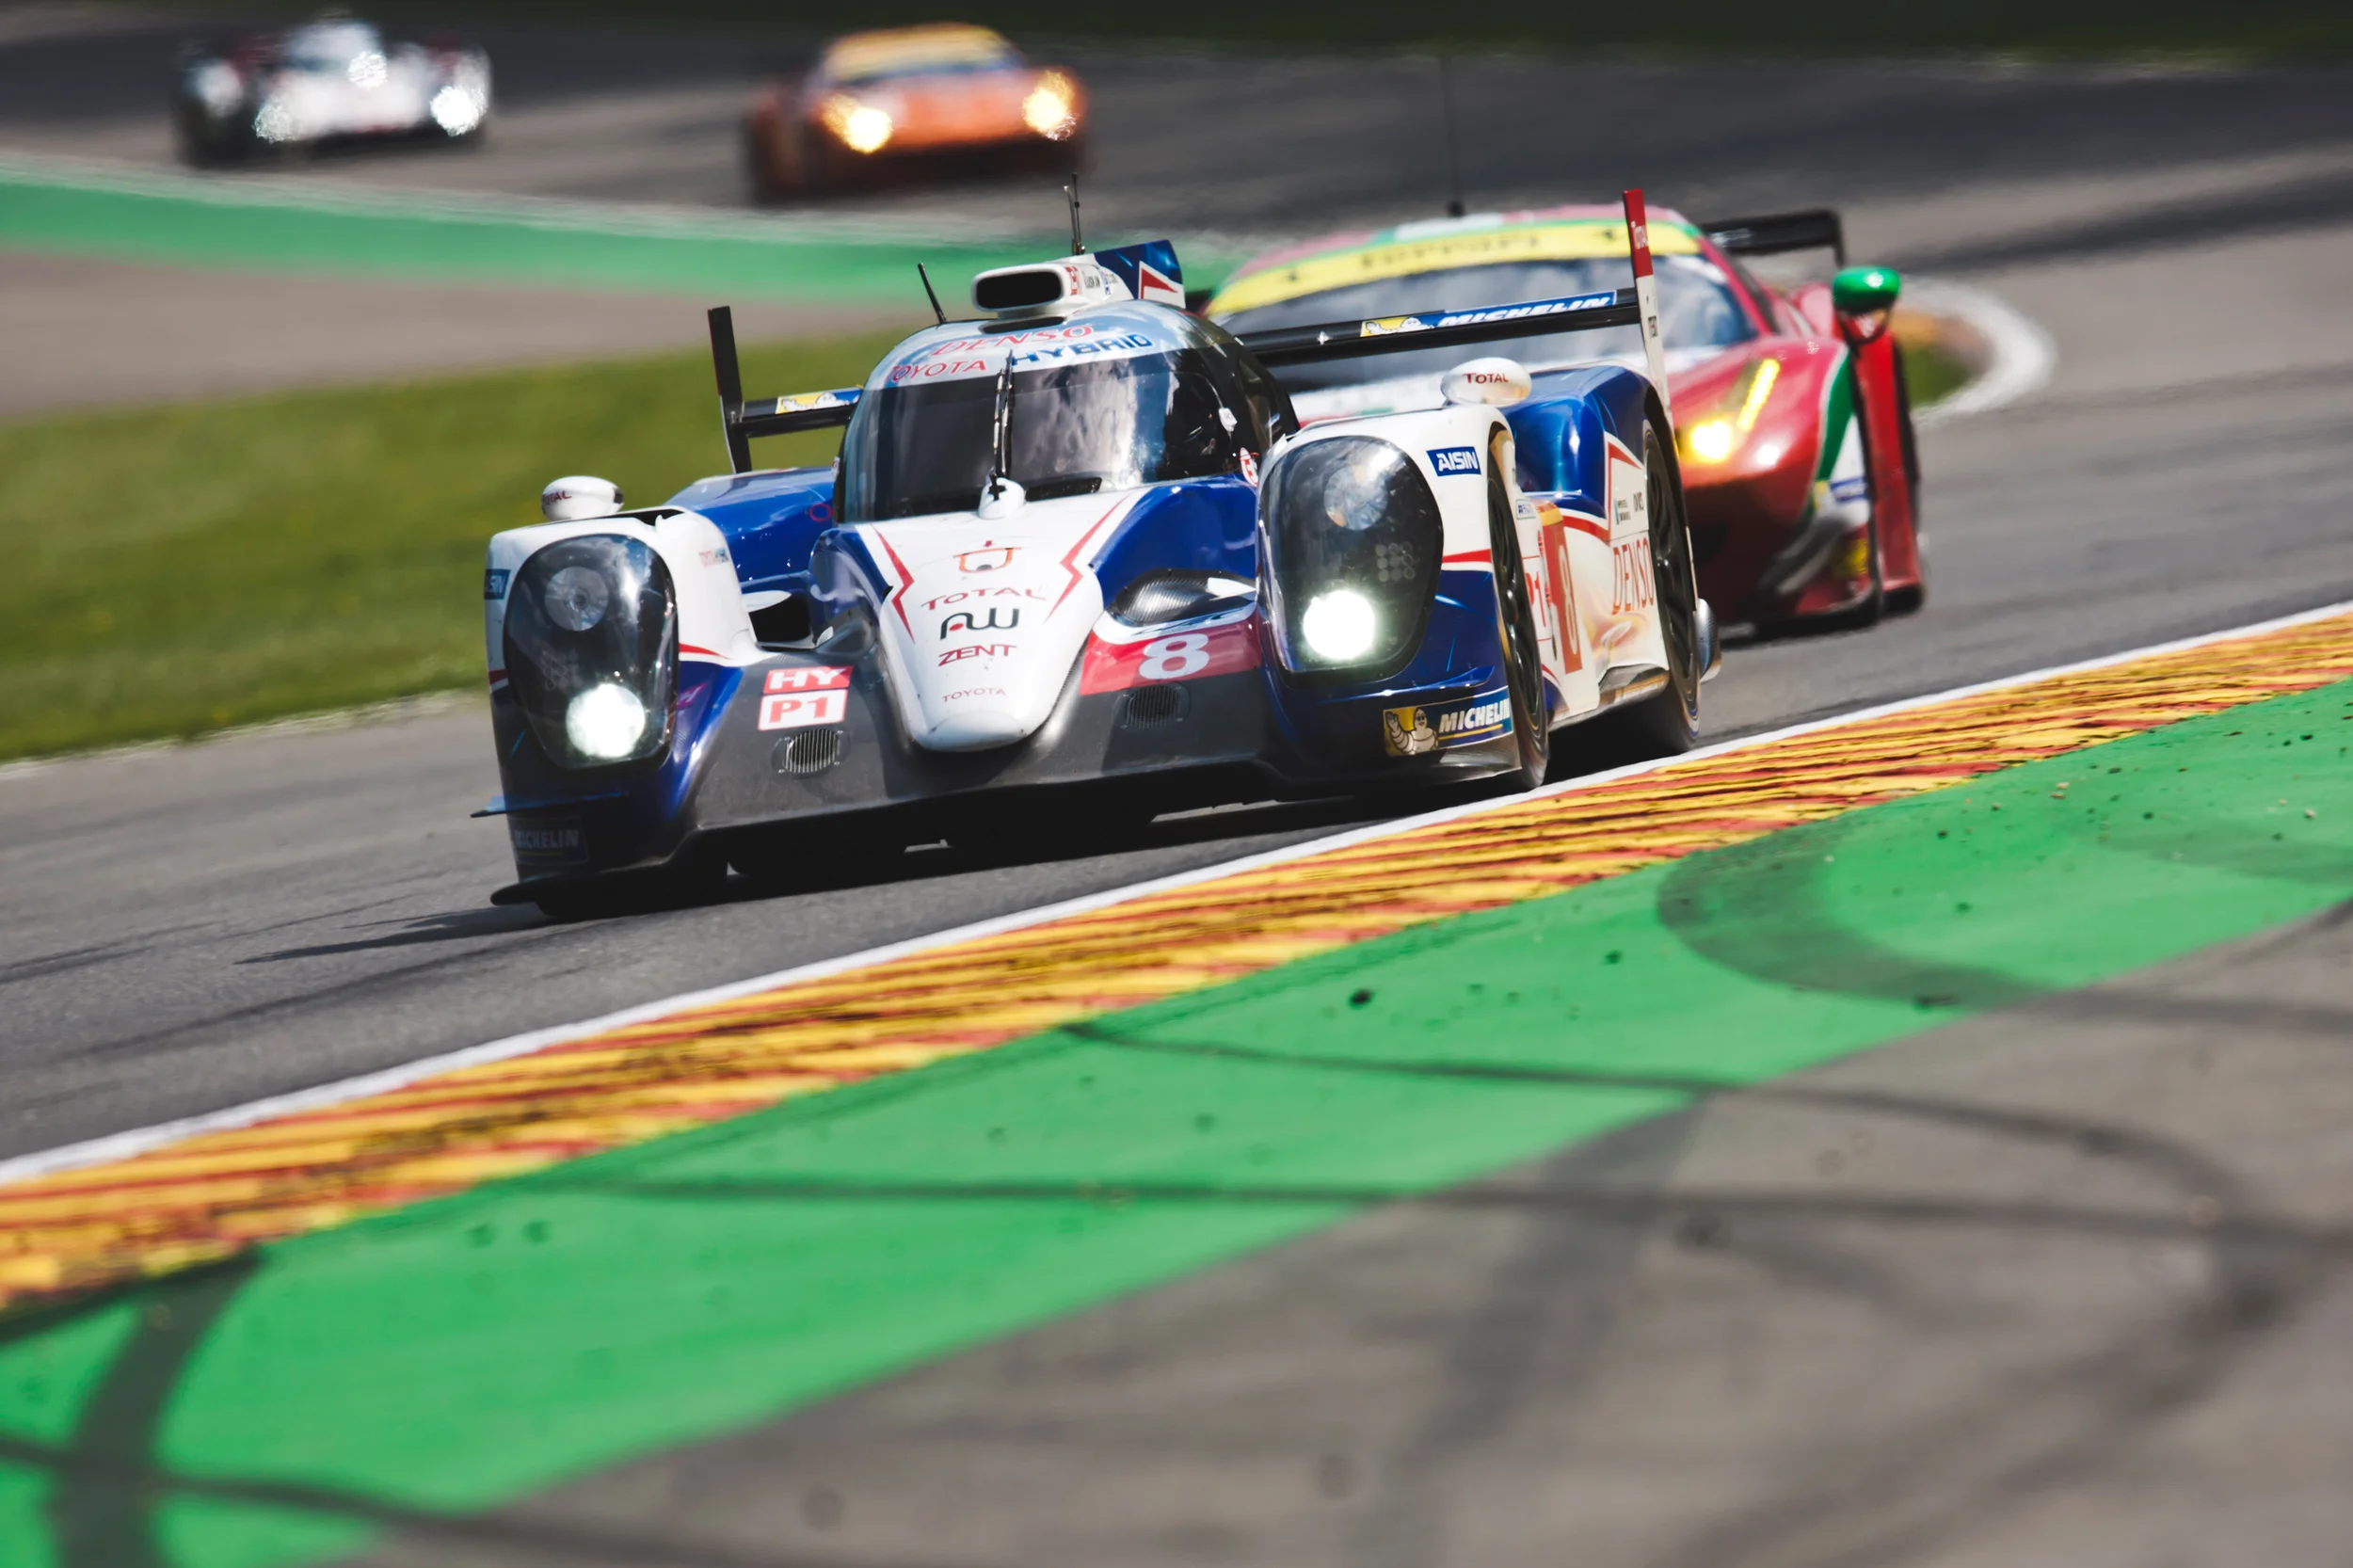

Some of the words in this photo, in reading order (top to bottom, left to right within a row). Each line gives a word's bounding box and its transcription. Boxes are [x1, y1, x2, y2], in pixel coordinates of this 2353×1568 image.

[1437, 296, 1611, 327] MICHELIN
[931, 325, 1094, 357] DENSO
[885, 360, 987, 382] TOYOTA
[1011, 333, 1154, 366] HYBRID
[1462, 373, 1509, 384] TOTAL
[1436, 451, 1479, 472] AISIN
[1611, 536, 1655, 616] DENSO
[920, 586, 1047, 611] TOTAL
[1559, 544, 1578, 655] 8
[937, 644, 1018, 667] ZENT
[1138, 633, 1210, 680] 8
[768, 667, 847, 690] HY
[941, 688, 1006, 703] TOYOTA
[769, 696, 828, 724] P1
[513, 828, 580, 850] MICHELIN
